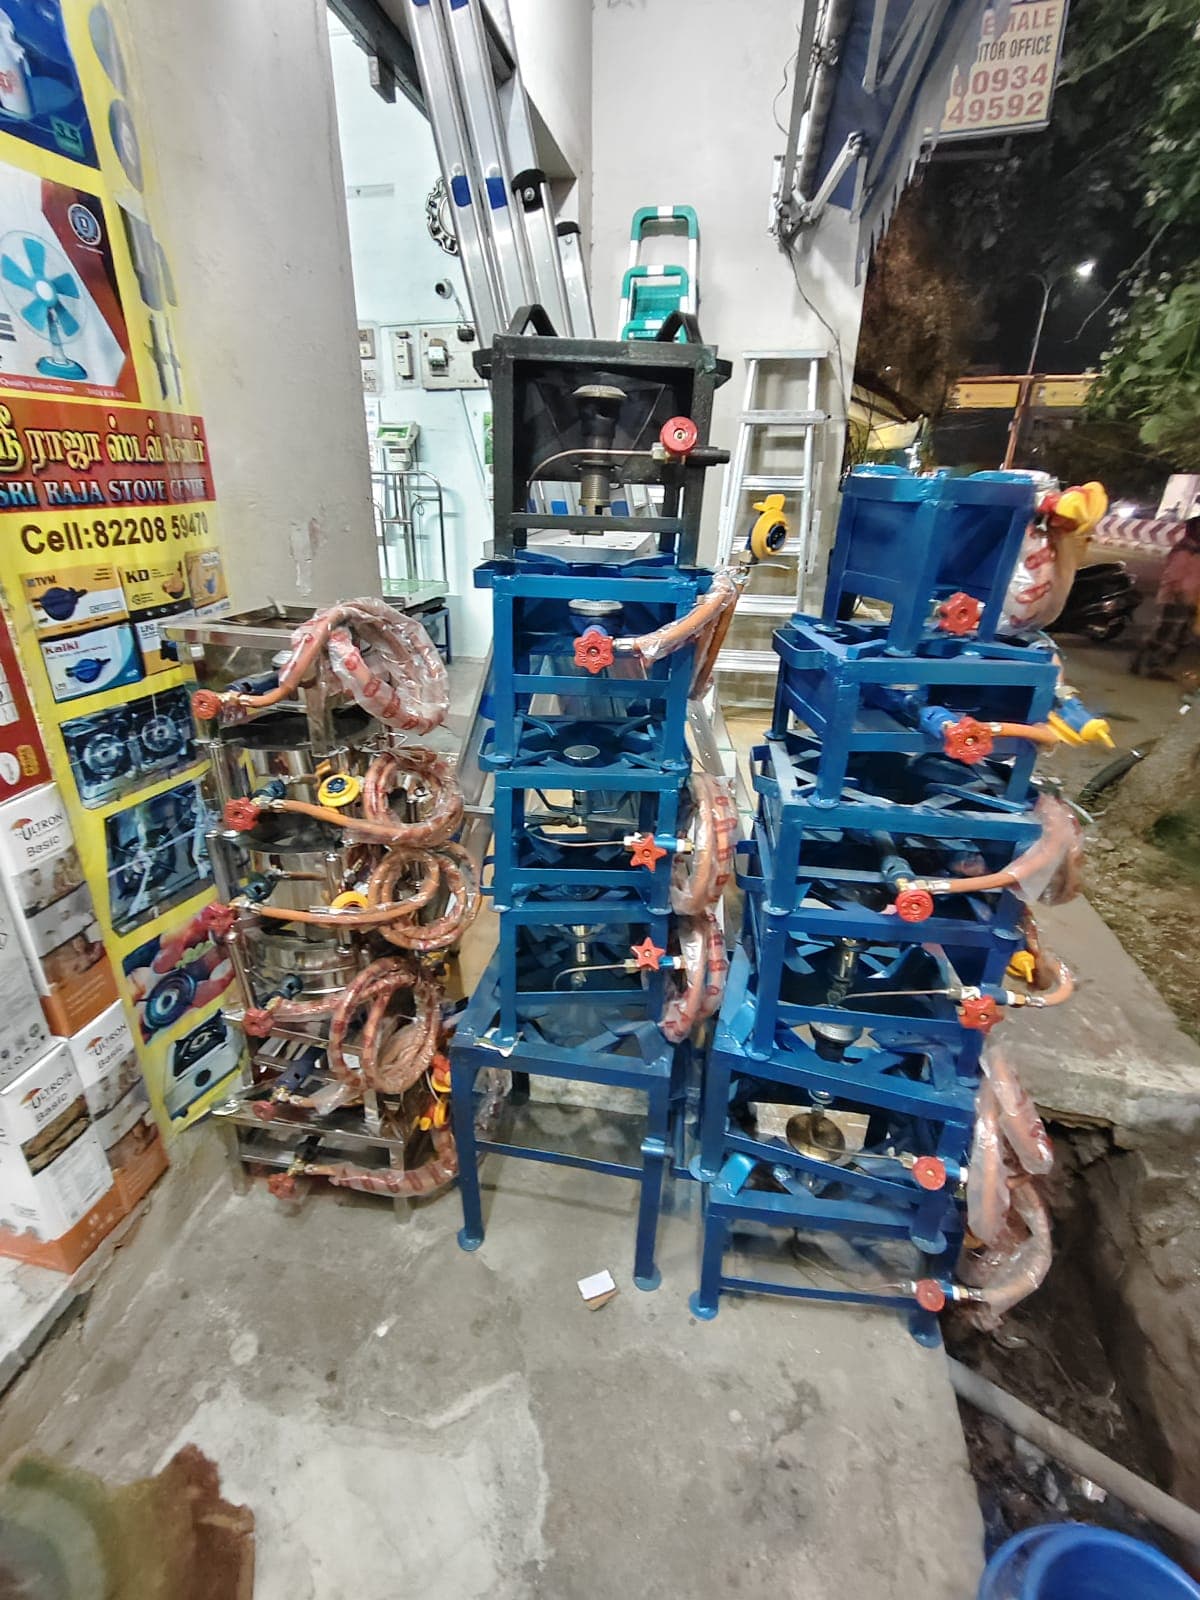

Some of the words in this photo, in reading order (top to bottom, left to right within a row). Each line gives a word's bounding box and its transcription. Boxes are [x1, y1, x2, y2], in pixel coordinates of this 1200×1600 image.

[1009, 34, 1053, 58] OFFICE
[948, 90, 1046, 124] 49592
[43, 479, 104, 506] RAJA
[108, 478, 168, 503] STOVE
[20, 516, 168, 555] Cell:82208
[171, 510, 209, 540] 59470
[126, 568, 150, 584] KD
[21, 812, 64, 841] ULTRON
